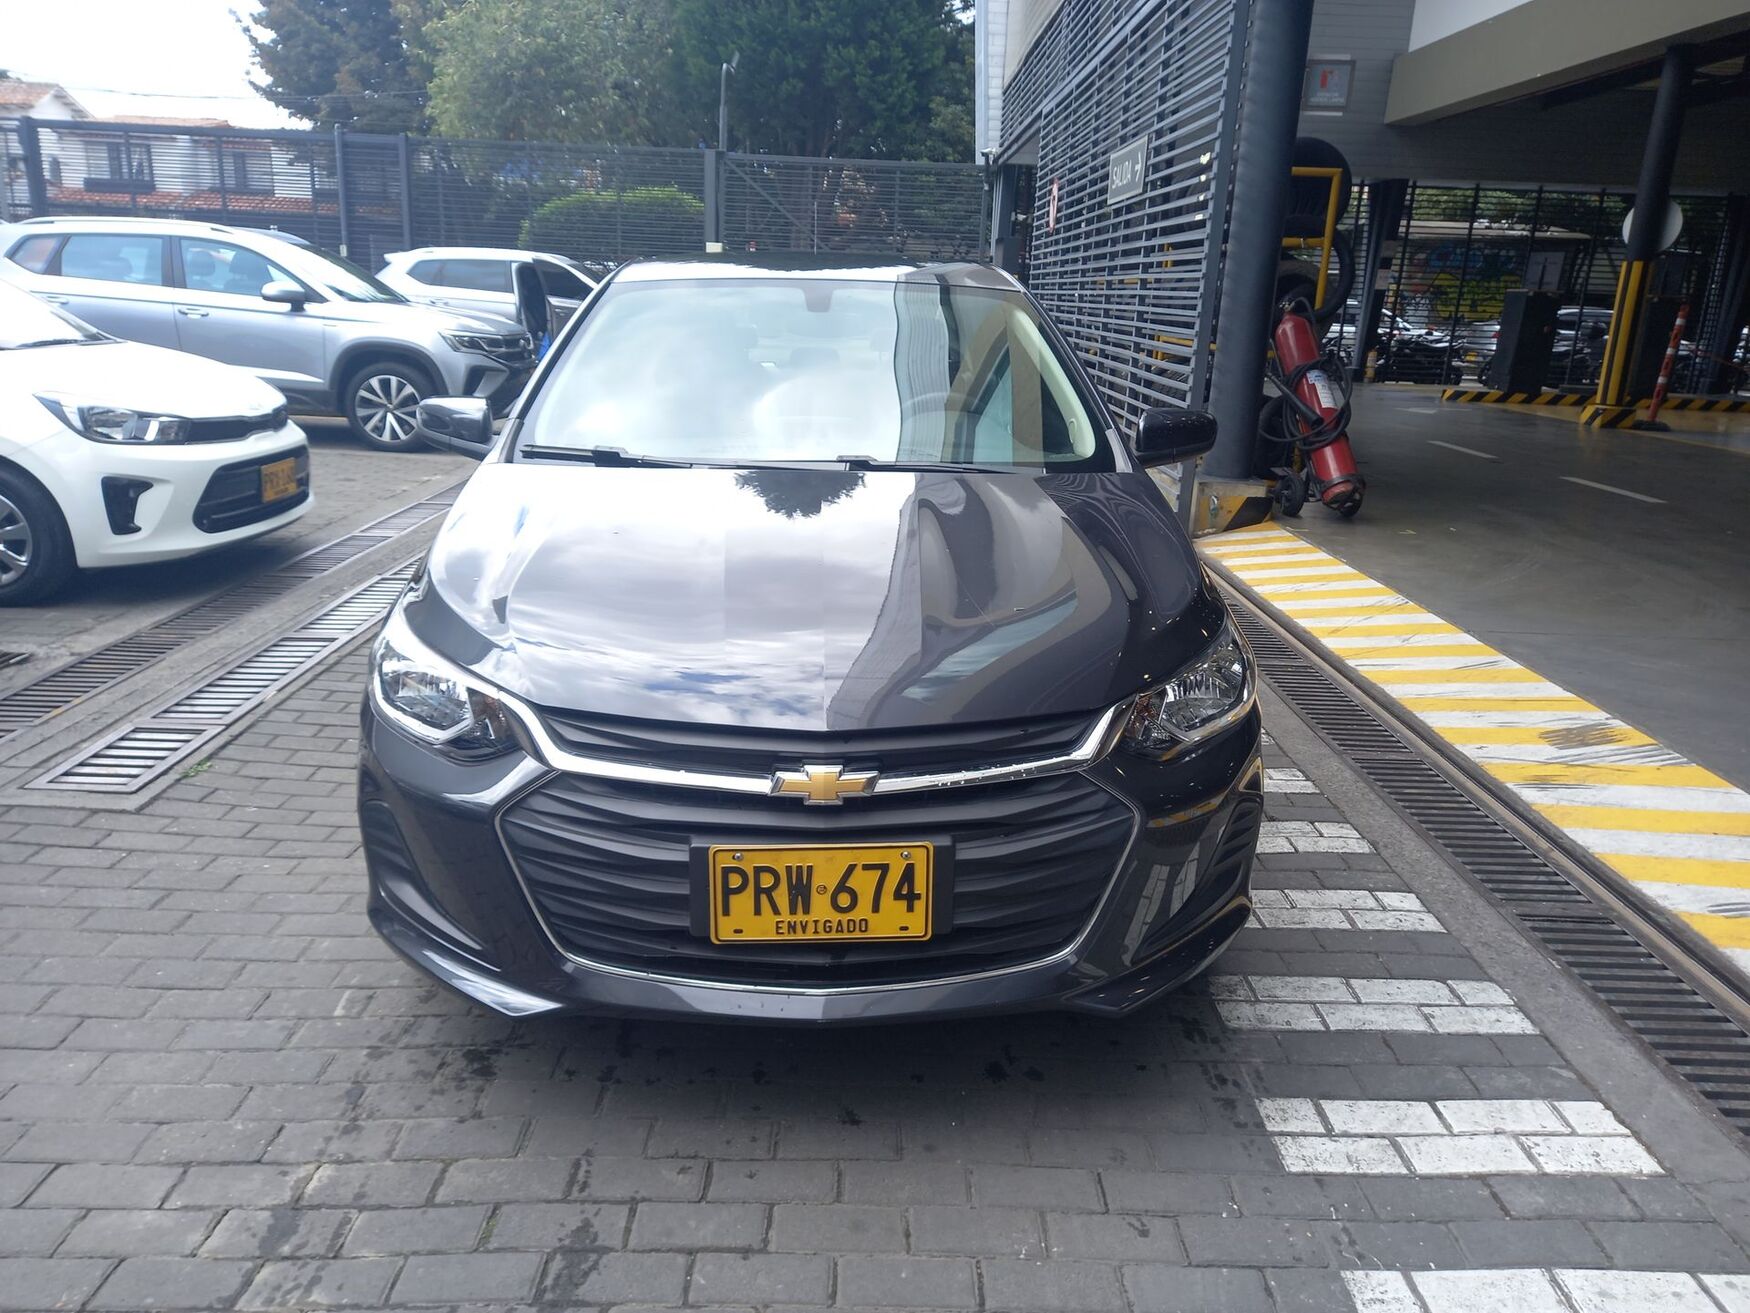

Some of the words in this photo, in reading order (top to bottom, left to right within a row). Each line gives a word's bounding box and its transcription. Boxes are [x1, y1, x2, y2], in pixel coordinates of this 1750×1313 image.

[1112, 160, 1132, 189] SALIDA
[720, 864, 814, 917] PRW
[830, 862, 922, 915] 674
[775, 918, 869, 935] ENVIGADO
